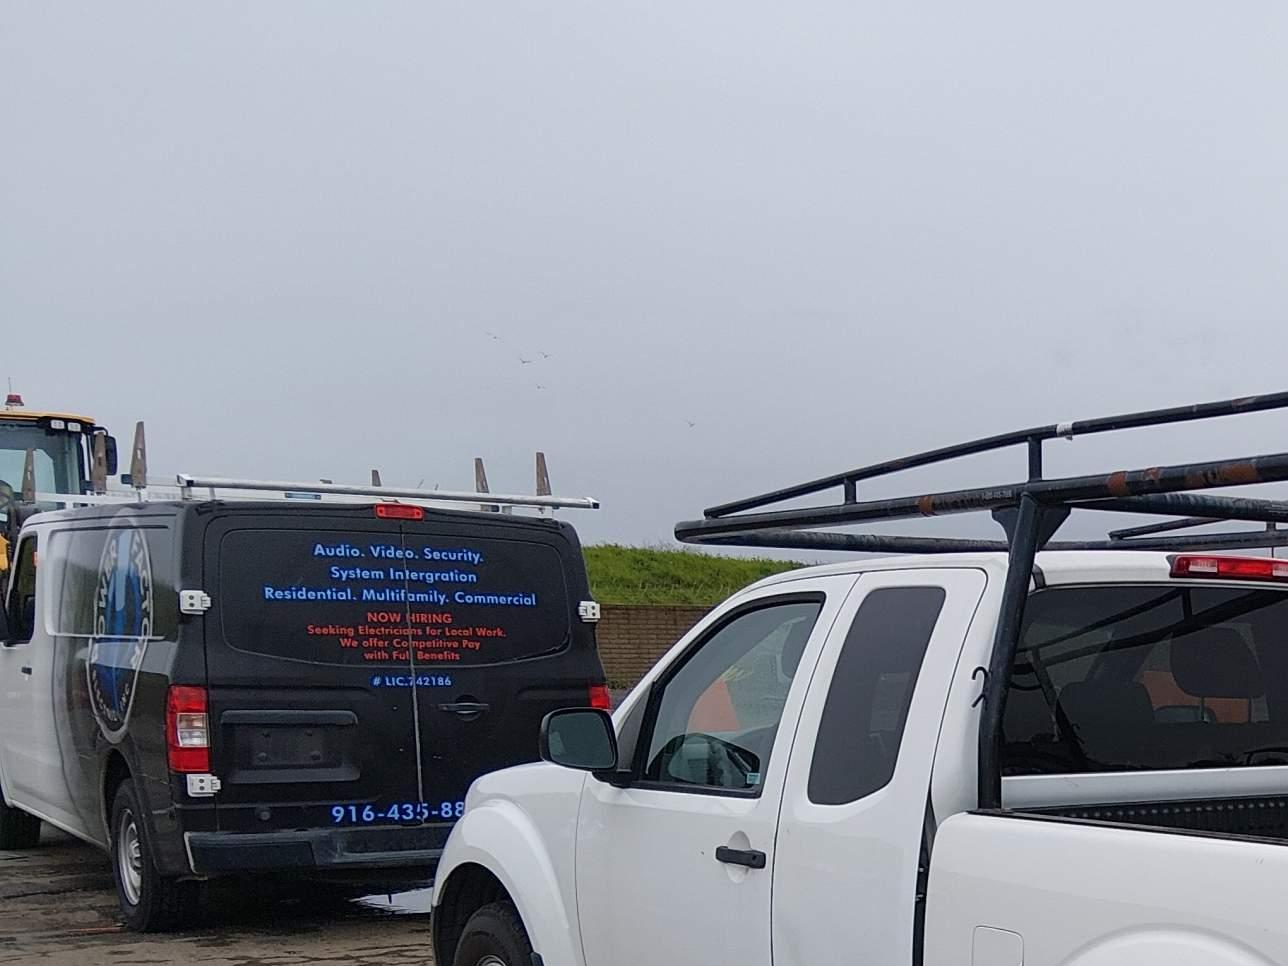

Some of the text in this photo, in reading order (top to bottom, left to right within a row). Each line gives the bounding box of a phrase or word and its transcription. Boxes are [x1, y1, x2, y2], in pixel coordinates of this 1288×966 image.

[314, 544, 484, 563] Audio. Video. Security.
[331, 566, 477, 583] System Intergration
[264, 587, 536, 606] Residential. Multifamily. Commercial
[367, 612, 453, 624] NOW HIRING
[307, 625, 507, 637] Seeking Electricians for Local Work.
[340, 638, 481, 651] We offer Competitive Pay
[364, 650, 460, 661] with Ful Benefits
[373, 677, 381, 687] #
